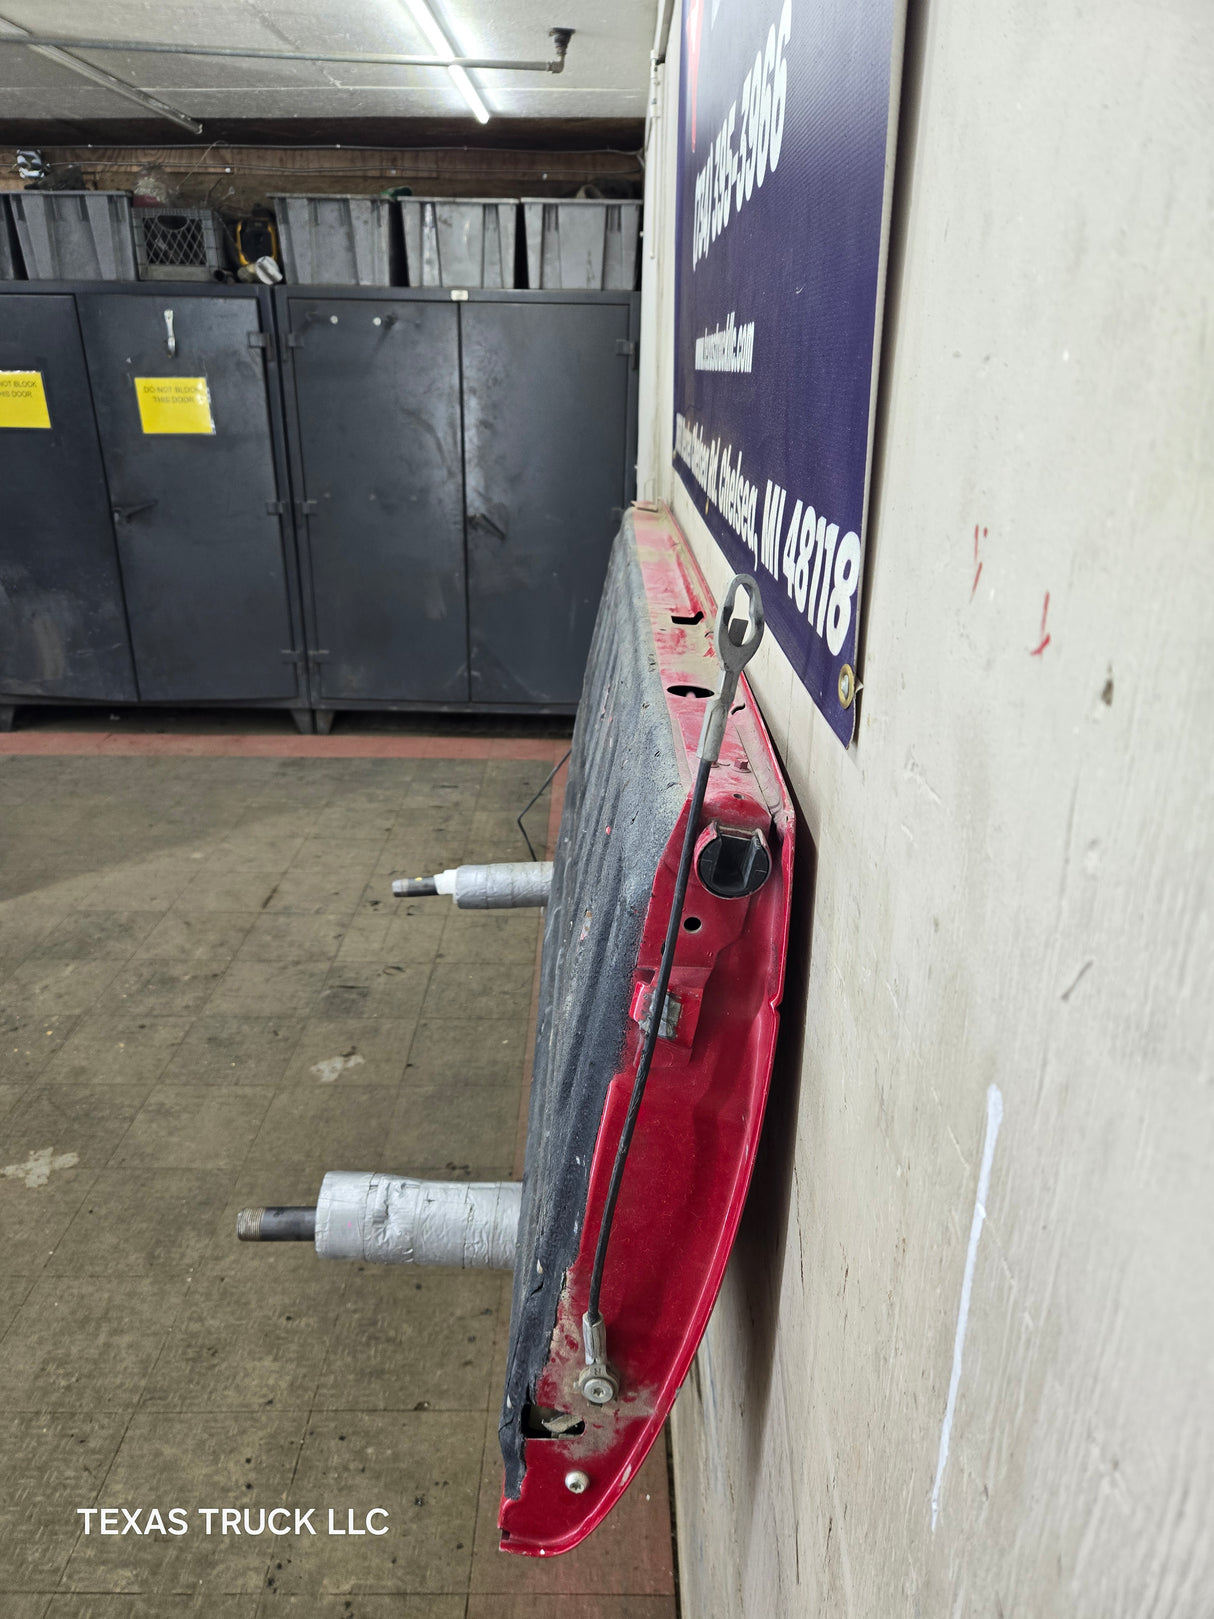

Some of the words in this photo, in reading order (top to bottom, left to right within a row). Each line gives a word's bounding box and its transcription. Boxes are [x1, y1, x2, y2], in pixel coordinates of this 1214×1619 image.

[712, 0, 792, 242] 395-3966
[718, 444, 759, 572] Chelsea,
[761, 480, 787, 581] MI
[783, 499, 861, 656] 48118
